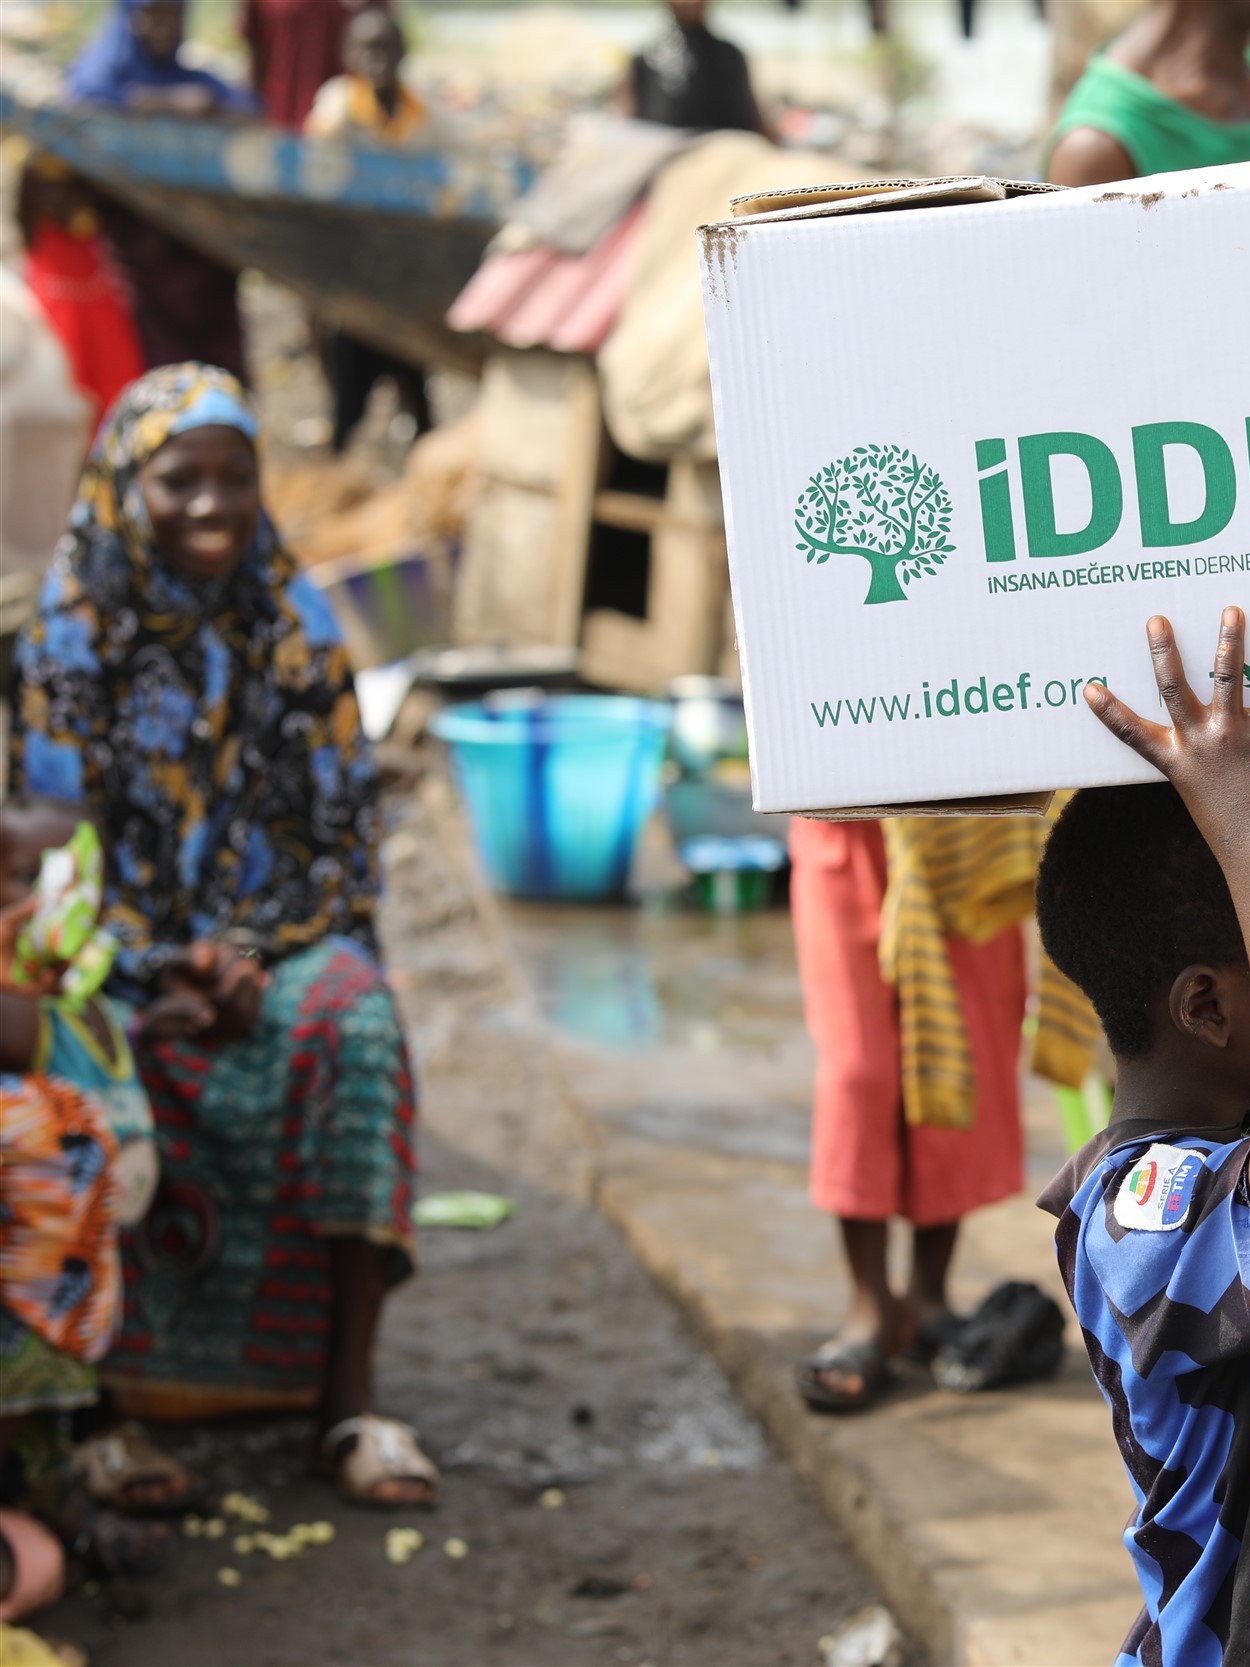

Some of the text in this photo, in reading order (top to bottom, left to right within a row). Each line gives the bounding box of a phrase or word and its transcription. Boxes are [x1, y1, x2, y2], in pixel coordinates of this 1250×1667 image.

[1062, 562, 1125, 587] DEĞER
[1126, 559, 1191, 581] VEREN
[1157, 1166, 1178, 1210] SERIE A
[1171, 1164, 1193, 1193] TIM
